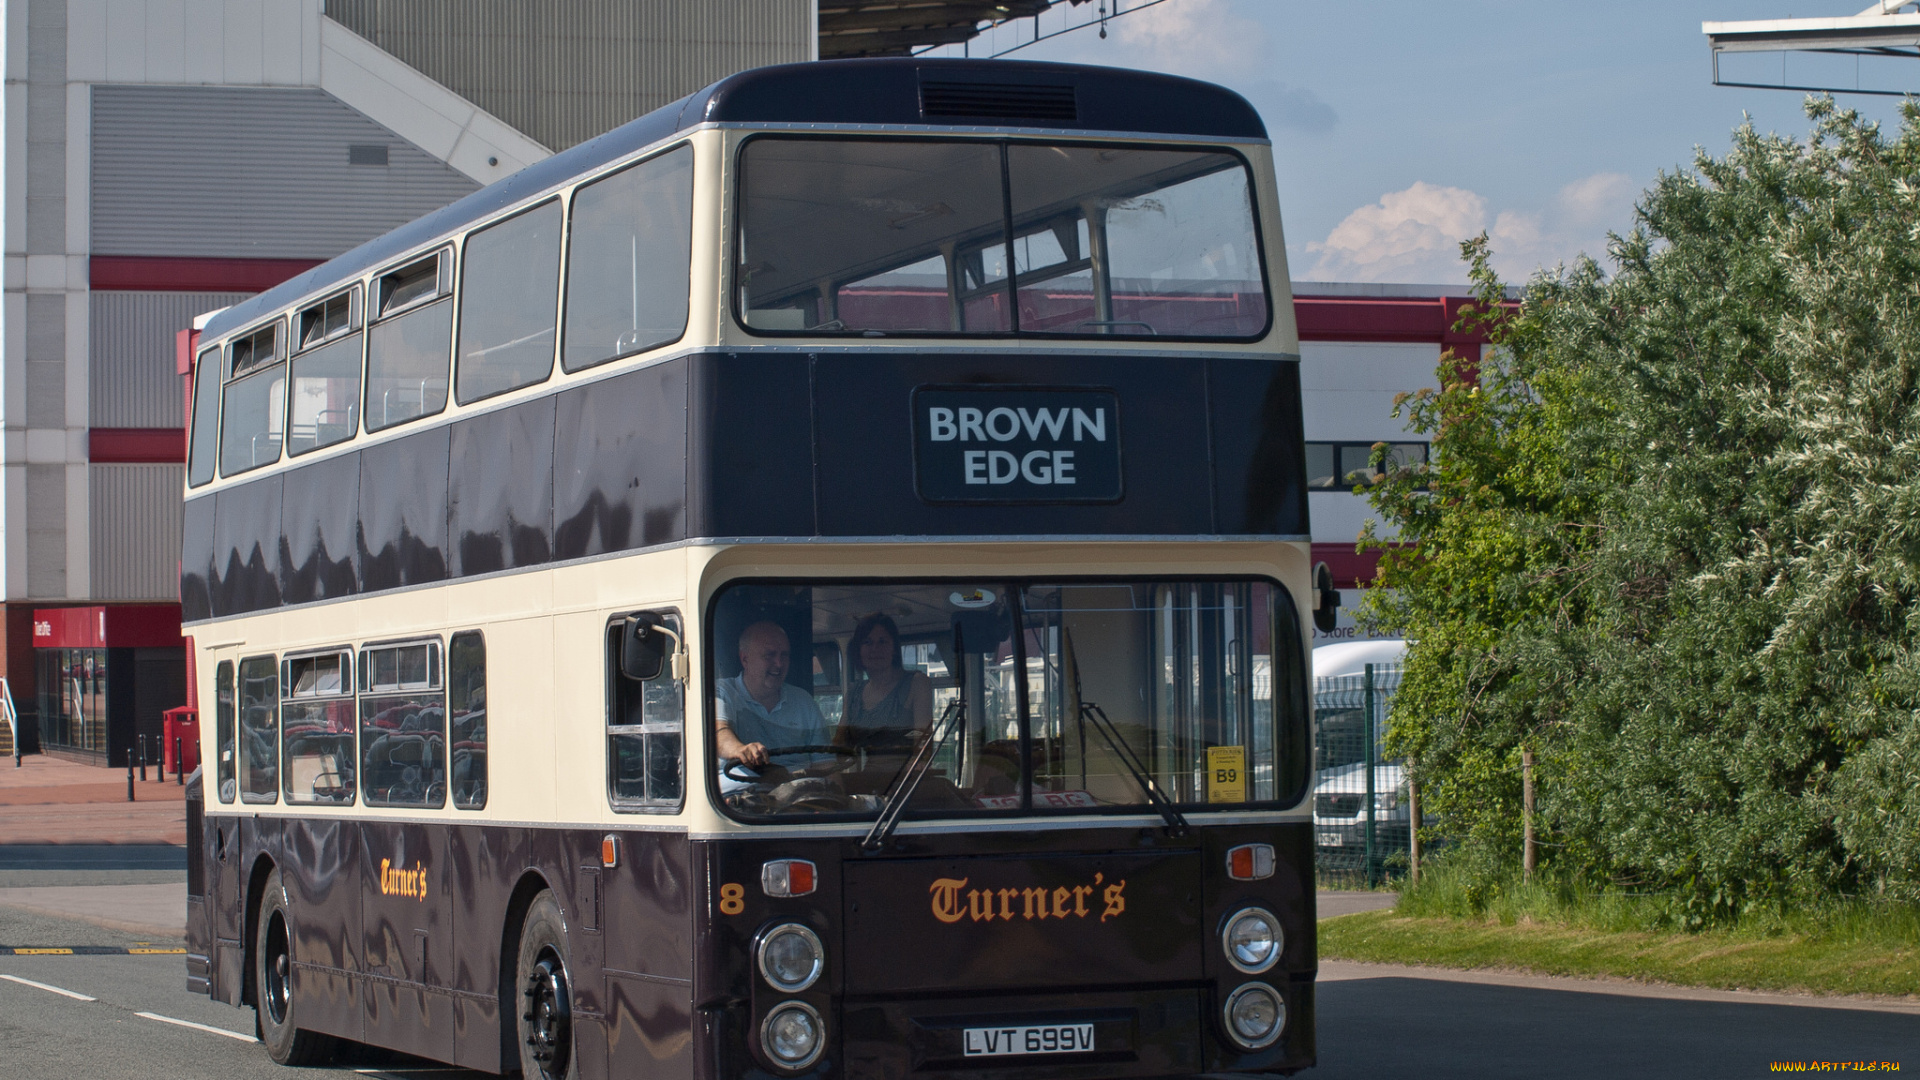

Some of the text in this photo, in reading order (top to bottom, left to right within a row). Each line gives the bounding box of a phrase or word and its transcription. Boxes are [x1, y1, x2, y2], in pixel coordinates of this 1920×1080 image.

[929, 407, 1106, 441] BROWN
[964, 450, 1076, 485] EDGE
[1216, 768, 1237, 783] B9
[381, 857, 427, 903] Turner's
[930, 872, 1126, 922] Turner's
[720, 883, 745, 915] 8
[966, 1026, 1092, 1054] LVT 699V
